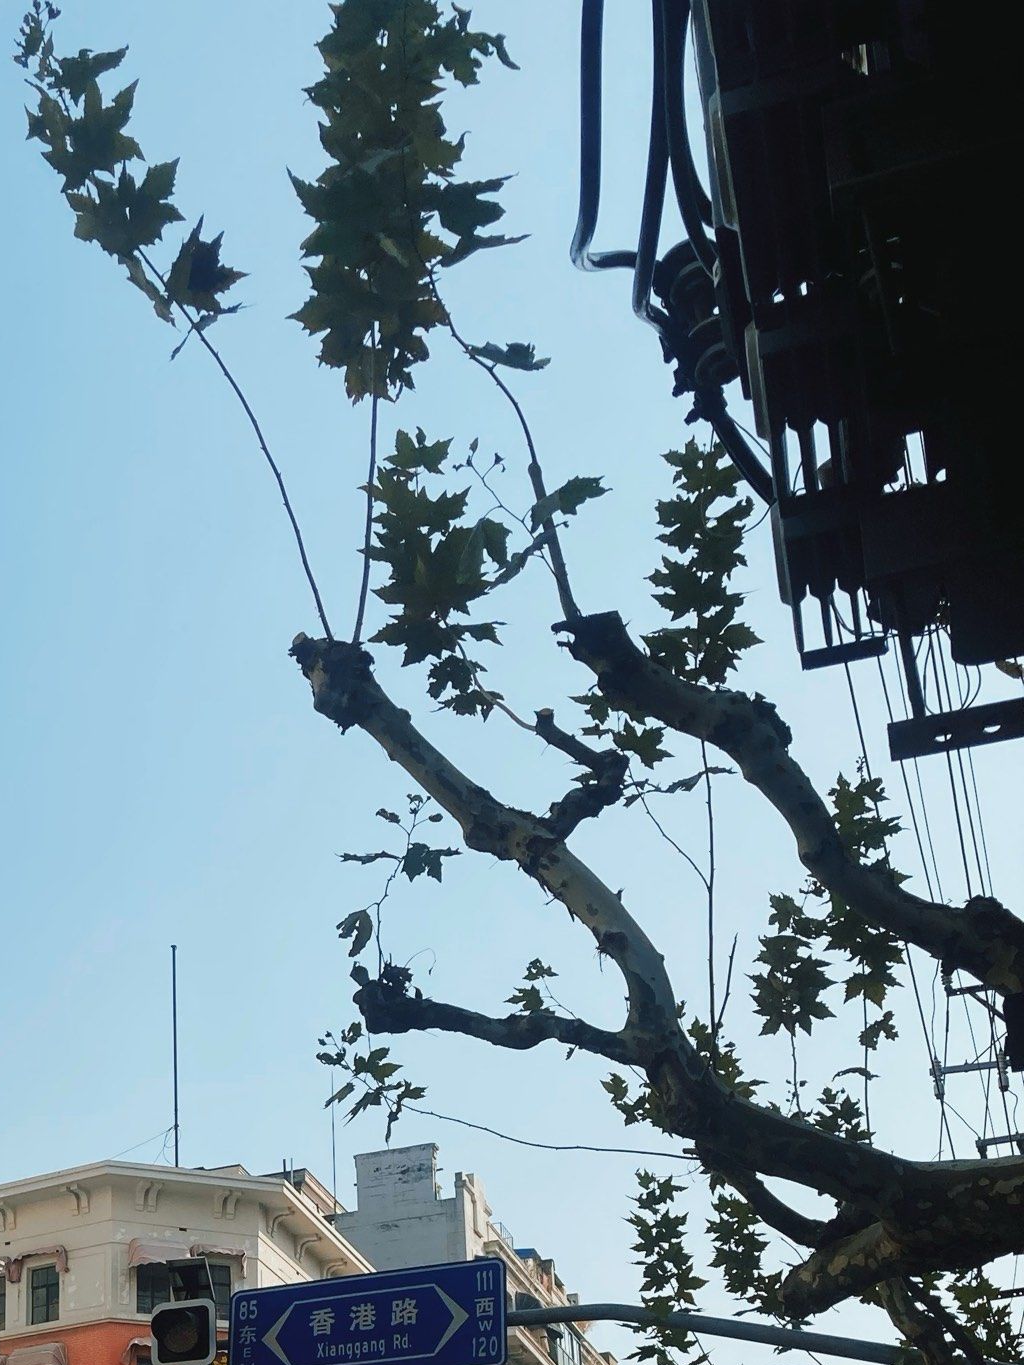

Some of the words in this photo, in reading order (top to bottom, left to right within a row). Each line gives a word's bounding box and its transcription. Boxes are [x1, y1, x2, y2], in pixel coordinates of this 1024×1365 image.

[476, 1270, 493, 1291] 111
[239, 1300, 258, 1320] 85
[309, 1297, 419, 1336] 香港路
[474, 1297, 495, 1318] 西
[239, 1325, 257, 1345] 东
[478, 1319, 493, 1332] W
[243, 1347, 252, 1358] E
[316, 1338, 386, 1359] Xianggang
[392, 1333, 412, 1350] Rd.
[472, 1336, 498, 1358] 120
